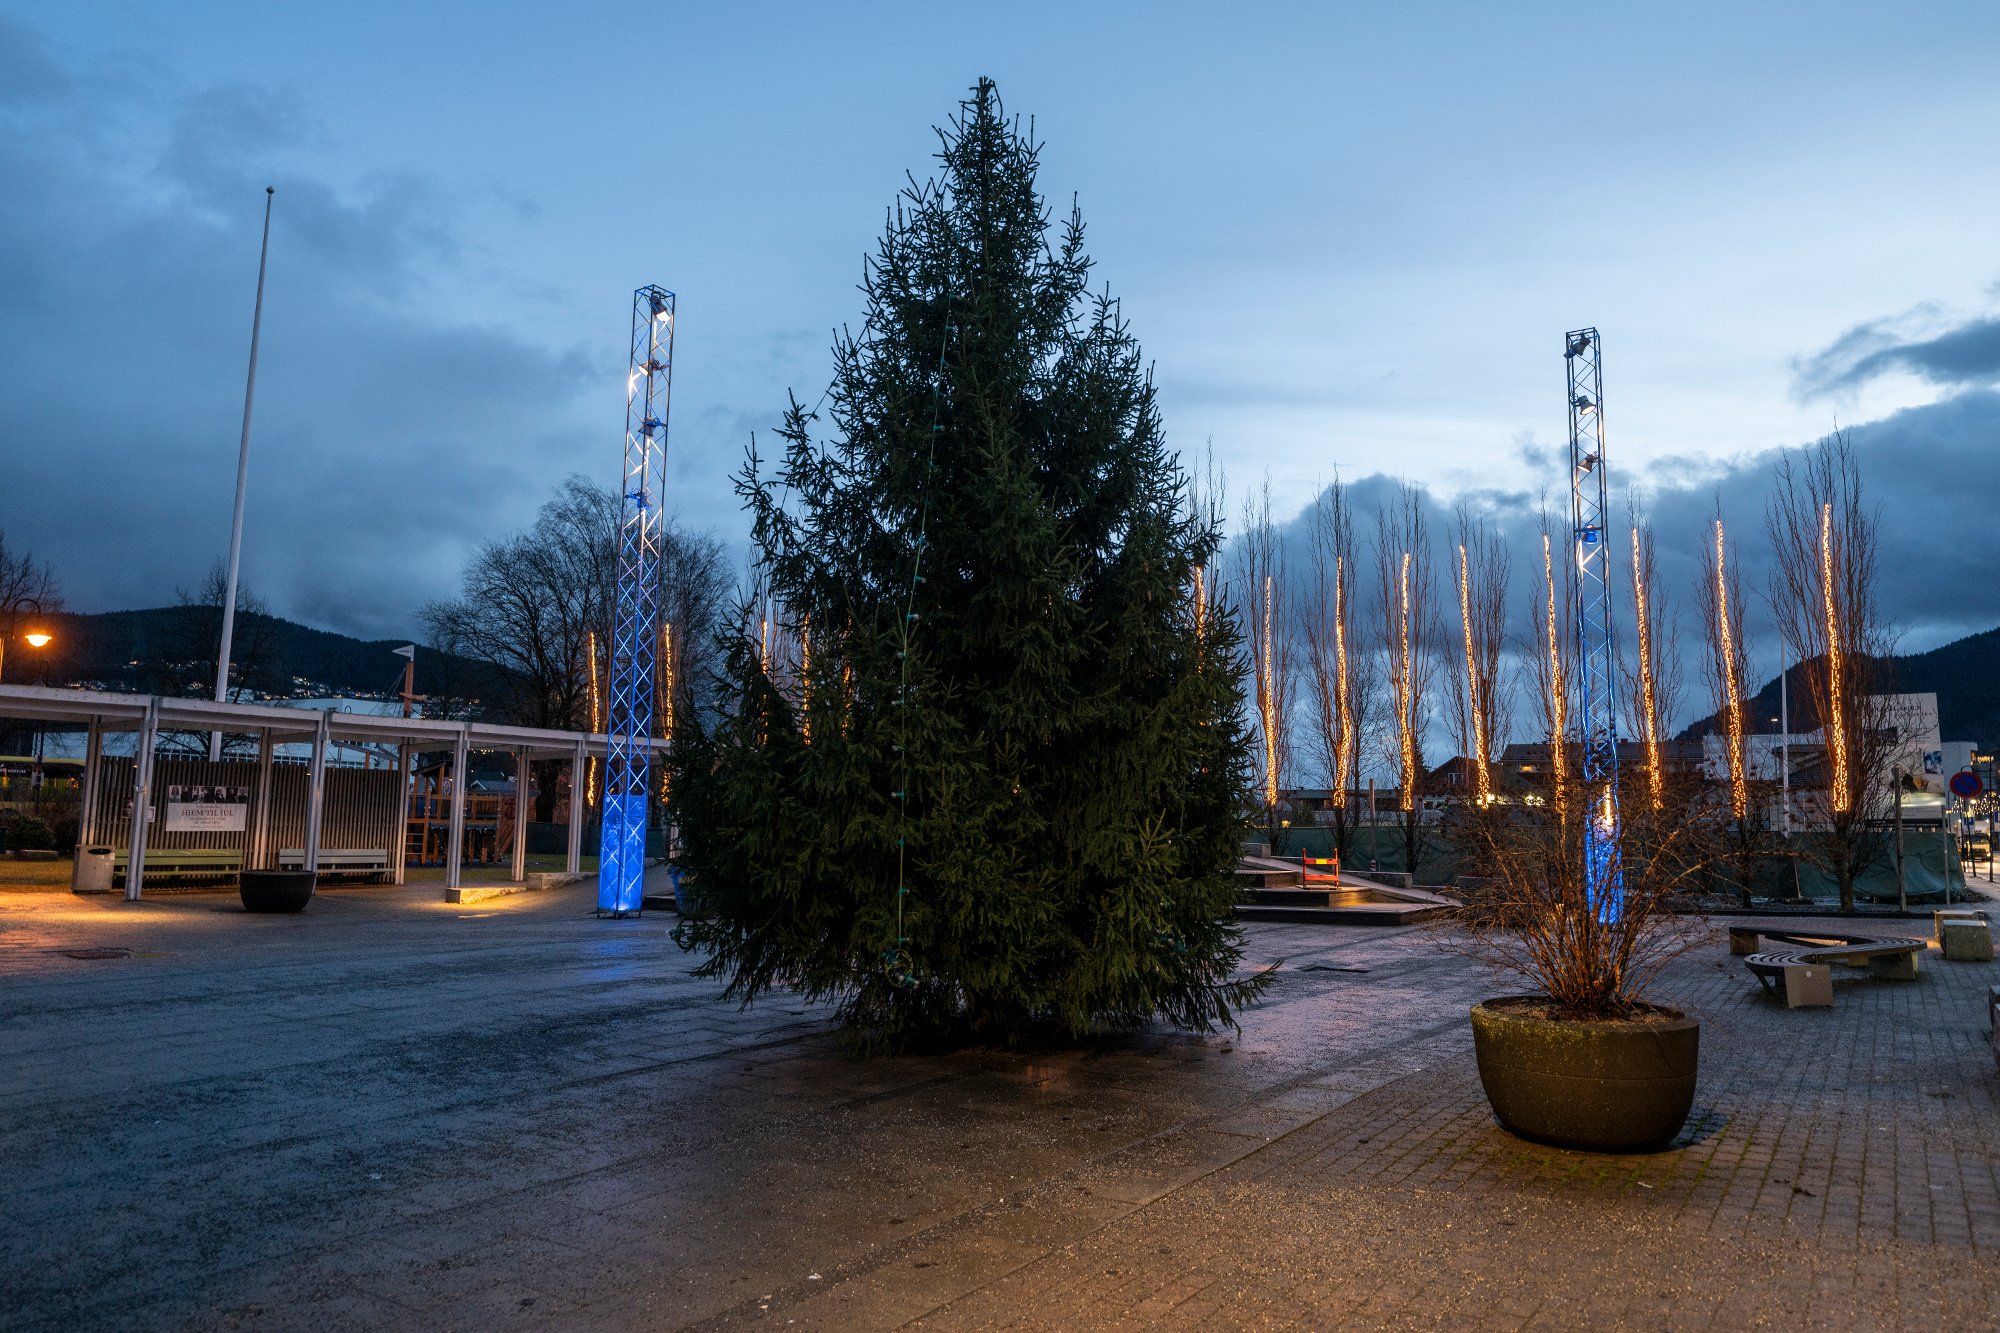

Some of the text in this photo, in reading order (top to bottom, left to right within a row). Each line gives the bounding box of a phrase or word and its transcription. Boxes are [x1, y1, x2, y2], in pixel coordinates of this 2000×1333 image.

[181, 809, 234, 817] HJEM TIL JUL
